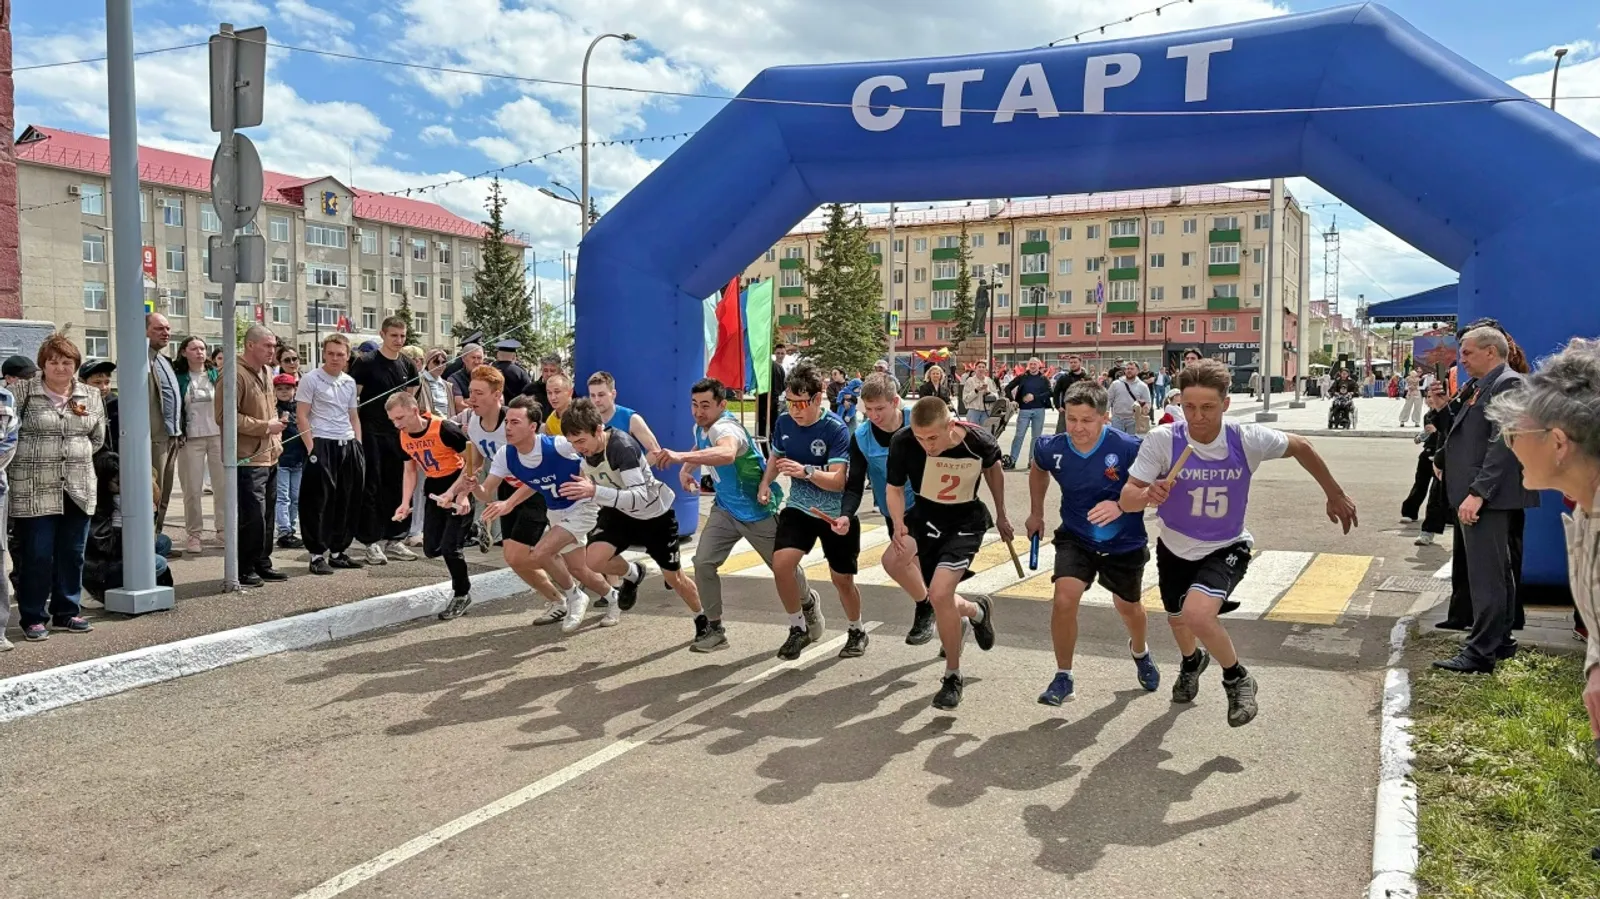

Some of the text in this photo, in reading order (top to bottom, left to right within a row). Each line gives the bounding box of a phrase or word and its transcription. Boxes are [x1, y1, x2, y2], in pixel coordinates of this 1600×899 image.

[851, 38, 1234, 132] СТАРТ
[144, 250, 152, 263] 9
[1218, 342, 1245, 350] COFFEE
[413, 450, 440, 472] 14
[479, 439, 497, 461] 11
[1052, 454, 1062, 470] 7
[540, 482, 561, 498] 7
[936, 474, 961, 501] 2
[1187, 486, 1229, 519] 15
